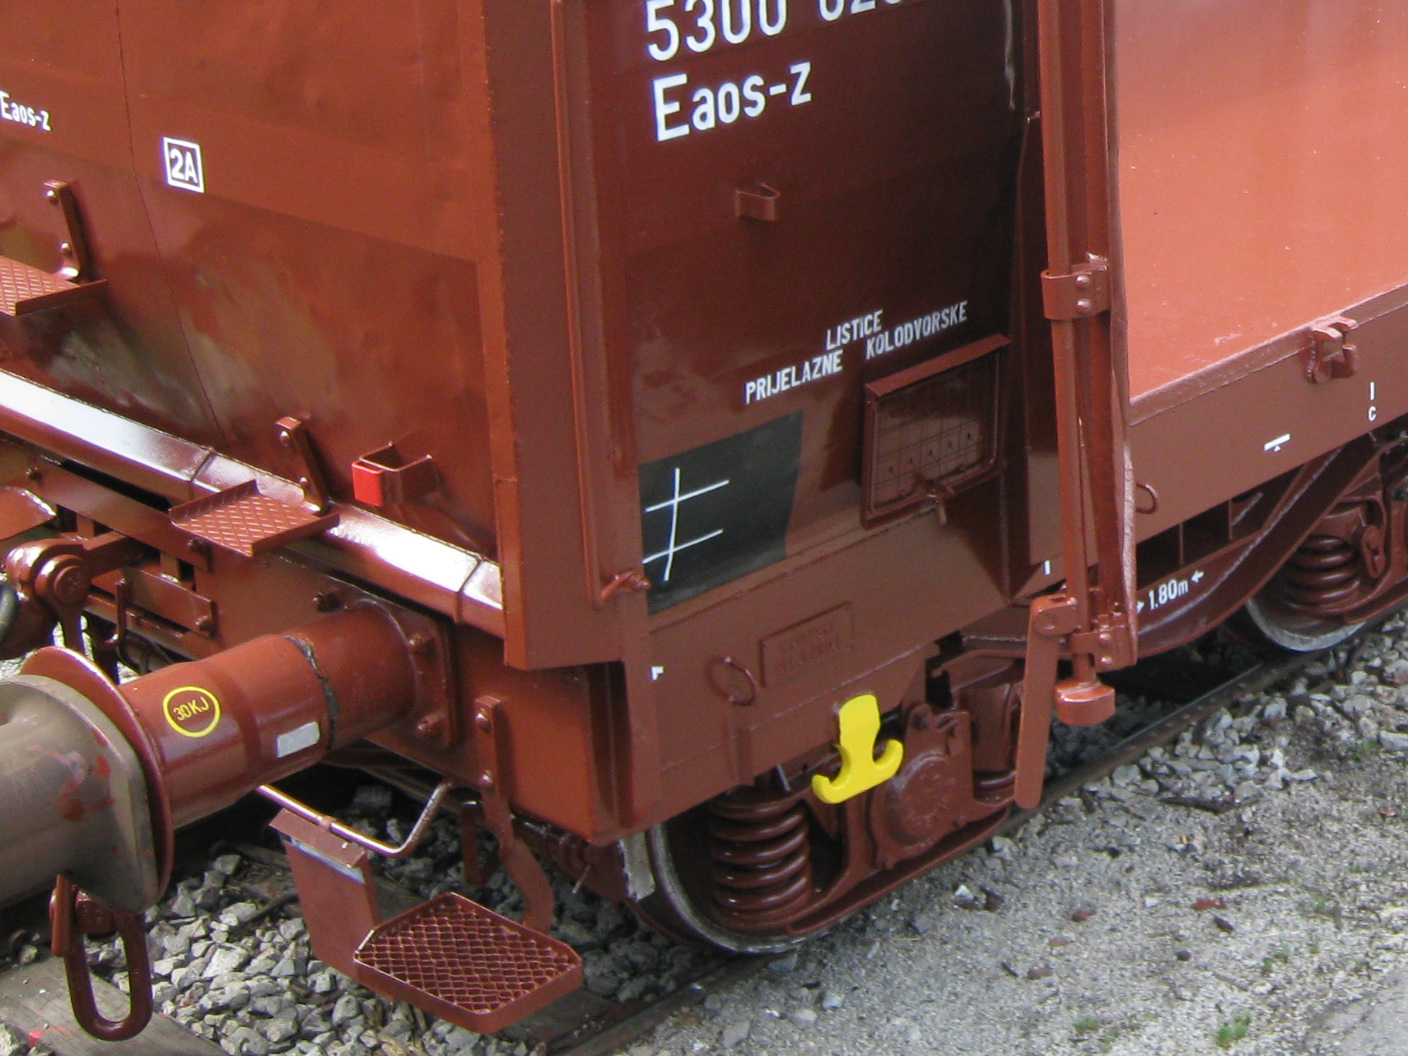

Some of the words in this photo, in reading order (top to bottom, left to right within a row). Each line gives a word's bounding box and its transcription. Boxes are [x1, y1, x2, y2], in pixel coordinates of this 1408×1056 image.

[652, 61, 812, 142] Eaos-z
[169, 147, 198, 184] 2A
[744, 349, 844, 405] PRIJELAZNE
[866, 300, 968, 360] KOLODVORSKE
[826, 308, 884, 350] LISTICE
